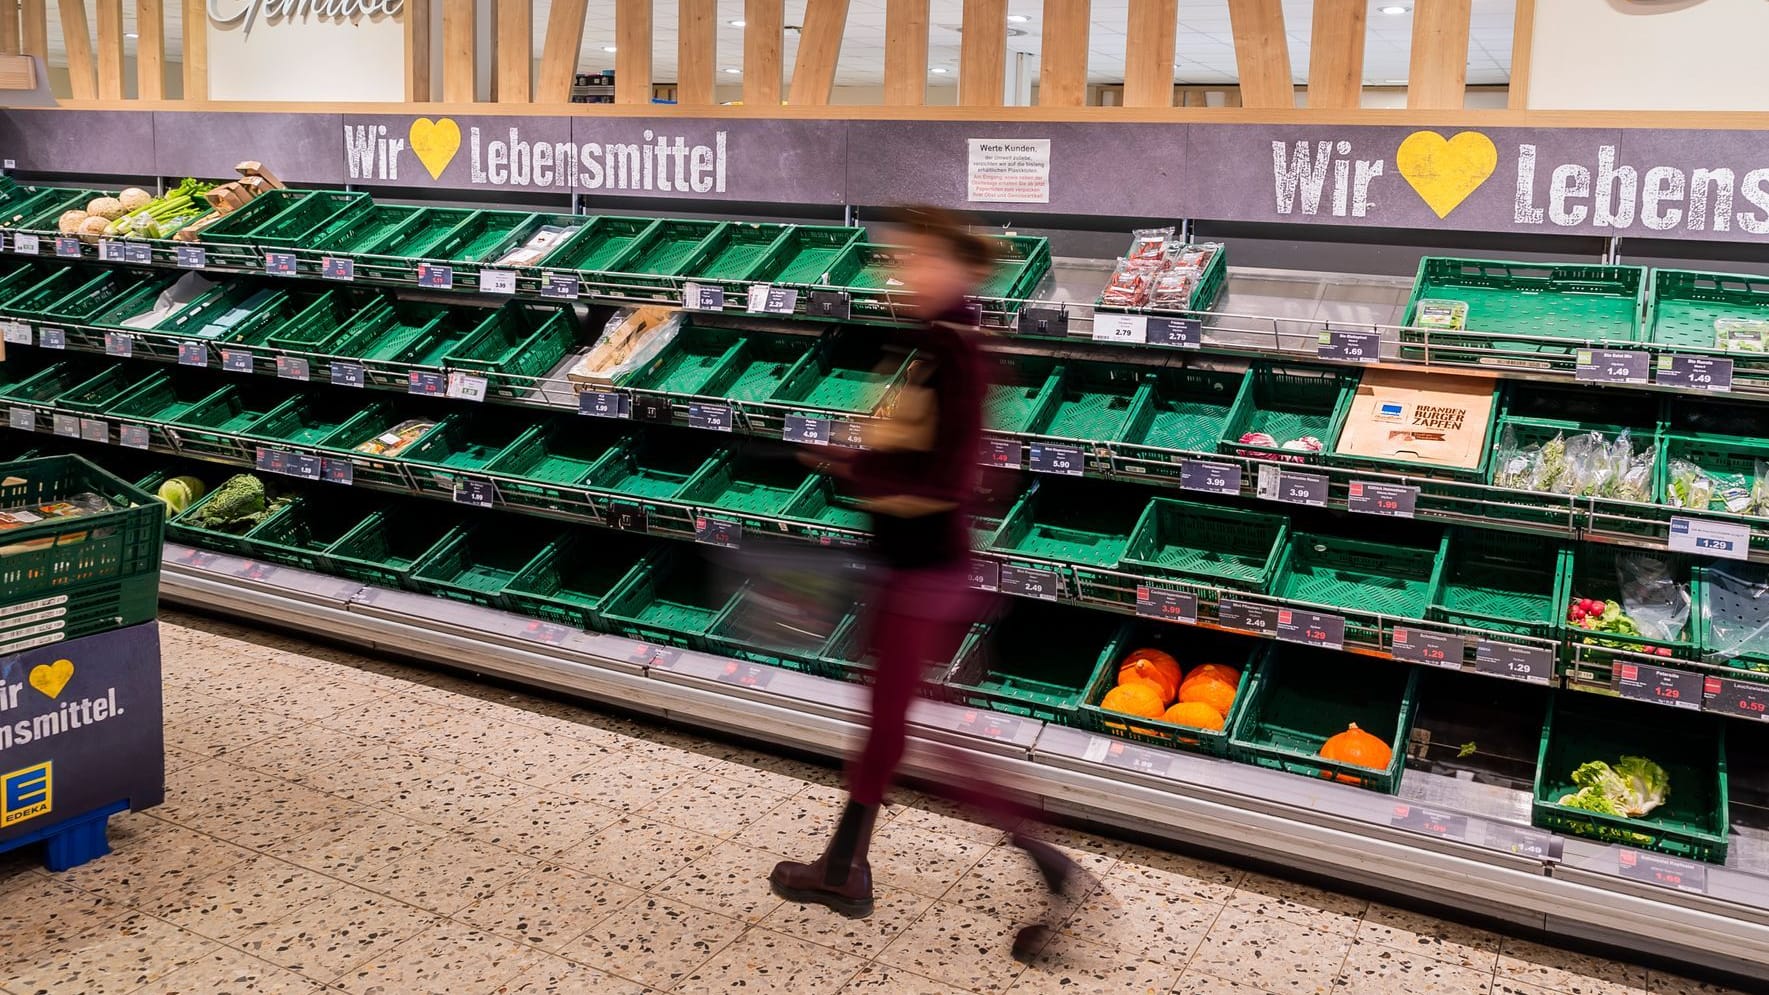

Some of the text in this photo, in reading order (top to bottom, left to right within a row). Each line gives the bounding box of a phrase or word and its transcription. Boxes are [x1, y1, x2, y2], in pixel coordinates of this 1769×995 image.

[343, 125, 404, 181] Wir
[980, 144, 1003, 152] Werte
[470, 126, 728, 193] Lebensmittel
[1272, 140, 1384, 217] Wir
[1169, 333, 1187, 341] 2.79
[1344, 348, 1363, 356] 1.69
[1607, 368, 1630, 376] 1.49
[1688, 374, 1712, 383] 1.49
[1416, 404, 1466, 416] BRANDEN
[1414, 410, 1465, 423] BURGER
[1412, 418, 1462, 430] ZAPFEN
[803, 430, 818, 438] 4.99
[1053, 460, 1070, 468] 5.90
[1206, 477, 1226, 486] 3.99
[1290, 488, 1310, 498] 3.99
[1703, 540, 1727, 549] 1.29
[1025, 583, 1042, 592] 2.49
[1162, 604, 1181, 614] 3.99
[1246, 618, 1266, 628] 2.49
[1306, 629, 1326, 640] 1.29
[1422, 648, 1444, 659] 1.29
[1508, 662, 1530, 673] 1.29
[1655, 686, 1680, 698] 1.29
[1739, 700, 1766, 712] 0.59
[5, 803, 48, 823] EDEKA
